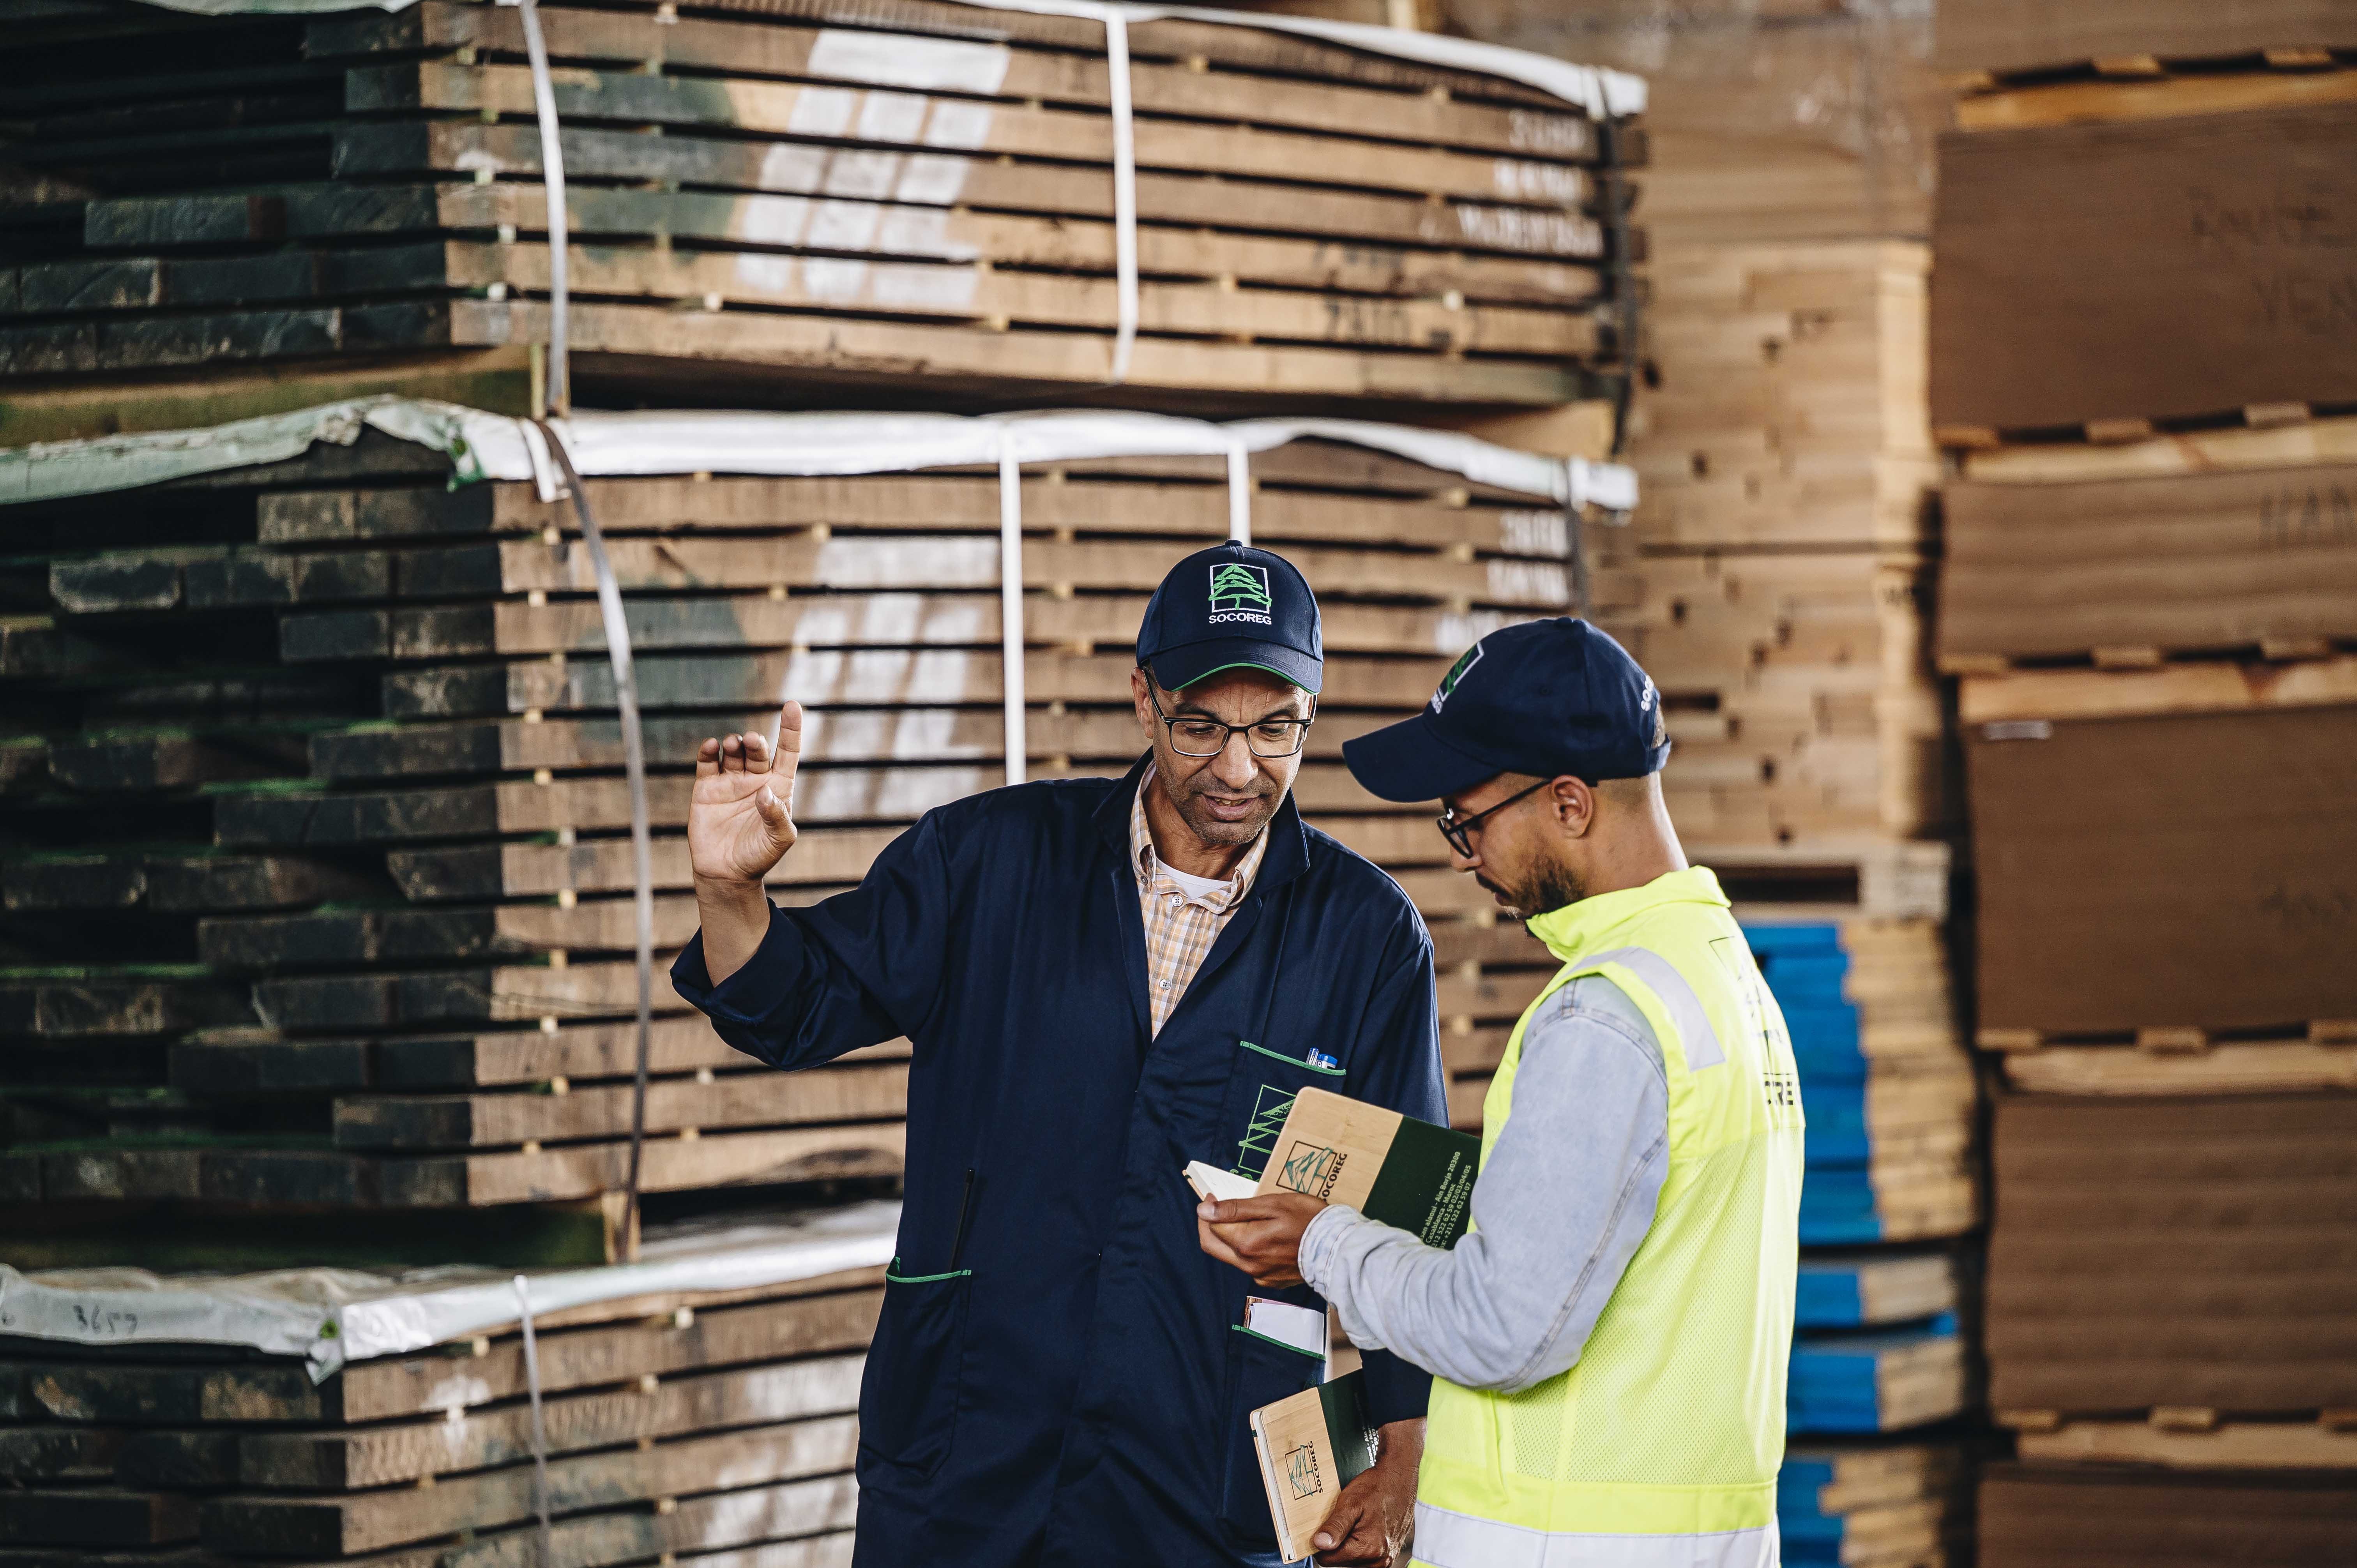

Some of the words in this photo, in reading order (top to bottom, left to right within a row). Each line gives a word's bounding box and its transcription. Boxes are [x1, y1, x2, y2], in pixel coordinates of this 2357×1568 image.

[1209, 613, 1272, 625] SOCOREG
[1322, 1153, 1348, 1202] OCOREG
[1425, 1206, 1437, 1226] alaoui
[1435, 1191, 1444, 1202] Ain
[1440, 1173, 1452, 1190] Borja
[1448, 1151, 1460, 1172] 20300
[1464, 1182, 1471, 1190] 07
[1437, 1222, 1446, 1234] 522
[1443, 1213, 1450, 1222] 62
[1447, 1204, 1454, 1213] 59
[1451, 1165, 1471, 1203] 02/03/04/05
[1460, 1191, 1467, 1200] 59
[1457, 1201, 1464, 1209] 62
[1426, 1208, 1445, 1243] Casablanca
[1443, 1183, 1456, 1203] Maroc
[1451, 1210, 1460, 1222] 522
[1445, 1223, 1454, 1238] +212
[1308, 1441, 1323, 1493] SOCOREG
